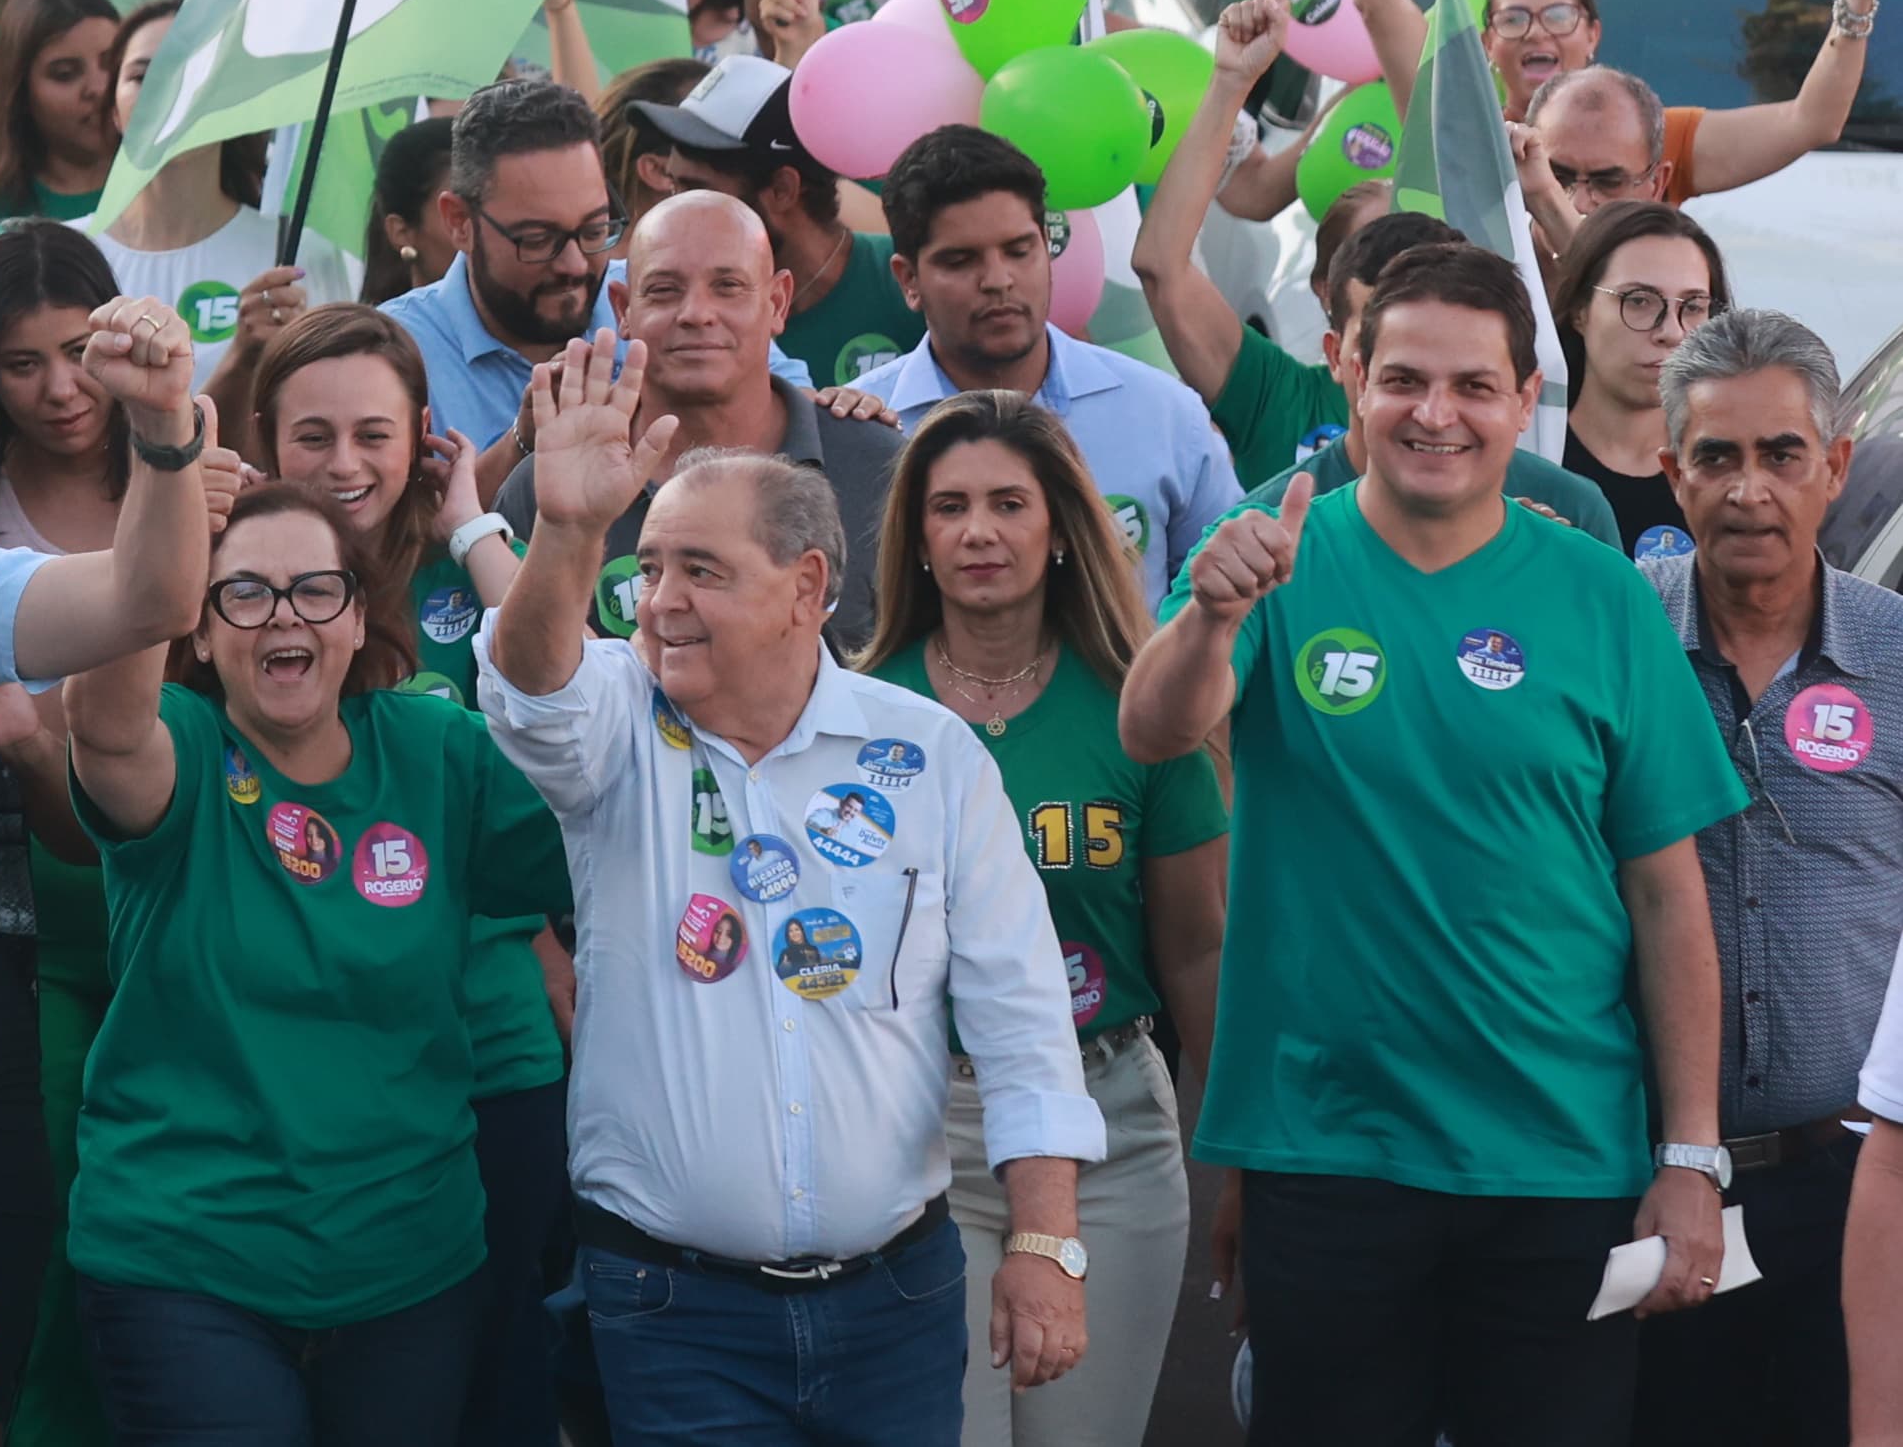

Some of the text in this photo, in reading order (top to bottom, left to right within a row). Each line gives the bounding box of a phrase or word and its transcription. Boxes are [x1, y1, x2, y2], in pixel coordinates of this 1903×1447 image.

[195, 296, 239, 331] 15
[1113, 504, 1143, 548] 5
[1311, 651, 1379, 698] é 15
[1470, 665, 1512, 684] 11114
[1813, 703, 1855, 741] 15
[868, 774, 911, 788] 11114
[813, 836, 860, 865] 44444
[1029, 801, 1125, 870] 15
[372, 839, 412, 877] 15
[748, 858, 793, 889] Ricardo
[759, 872, 798, 901] 44000
[1066, 952, 1087, 992] 5
[1072, 990, 1101, 1013] ERIO
